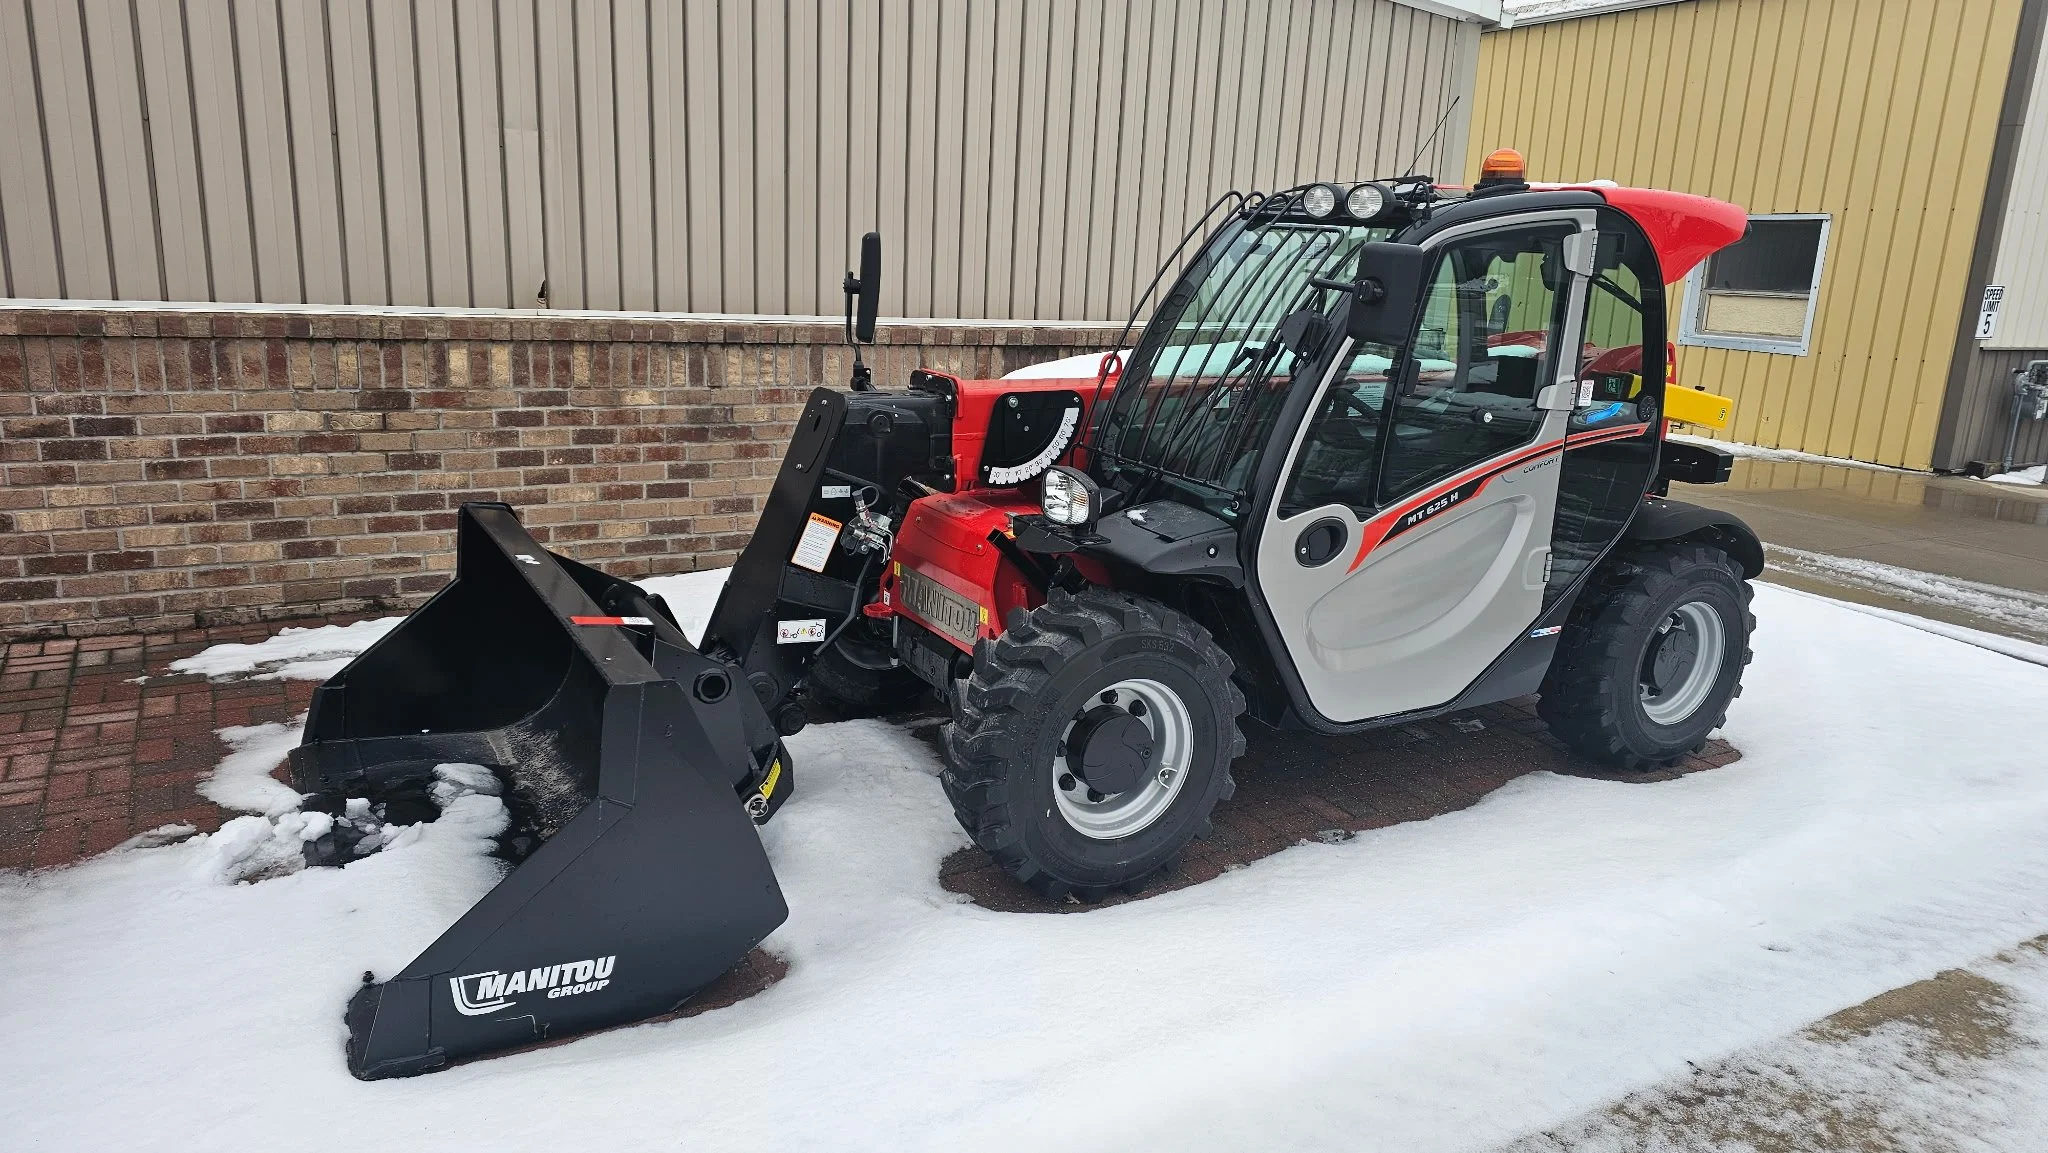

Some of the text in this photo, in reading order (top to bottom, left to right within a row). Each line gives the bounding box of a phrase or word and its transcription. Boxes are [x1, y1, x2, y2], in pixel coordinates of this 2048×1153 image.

[1985, 289, 2004, 300] SPEED
[1982, 301, 2000, 312] LIMIT
[1983, 314, 1992, 334] 5
[1523, 455, 1560, 473] COMFORT
[1407, 491, 1459, 525] MT 625 H
[816, 516, 840, 529] WARNING
[901, 573, 978, 638] MANITOU
[1141, 639, 1157, 649] SKS
[475, 955, 616, 1001] MANITOU
[547, 979, 610, 999] GROUP
